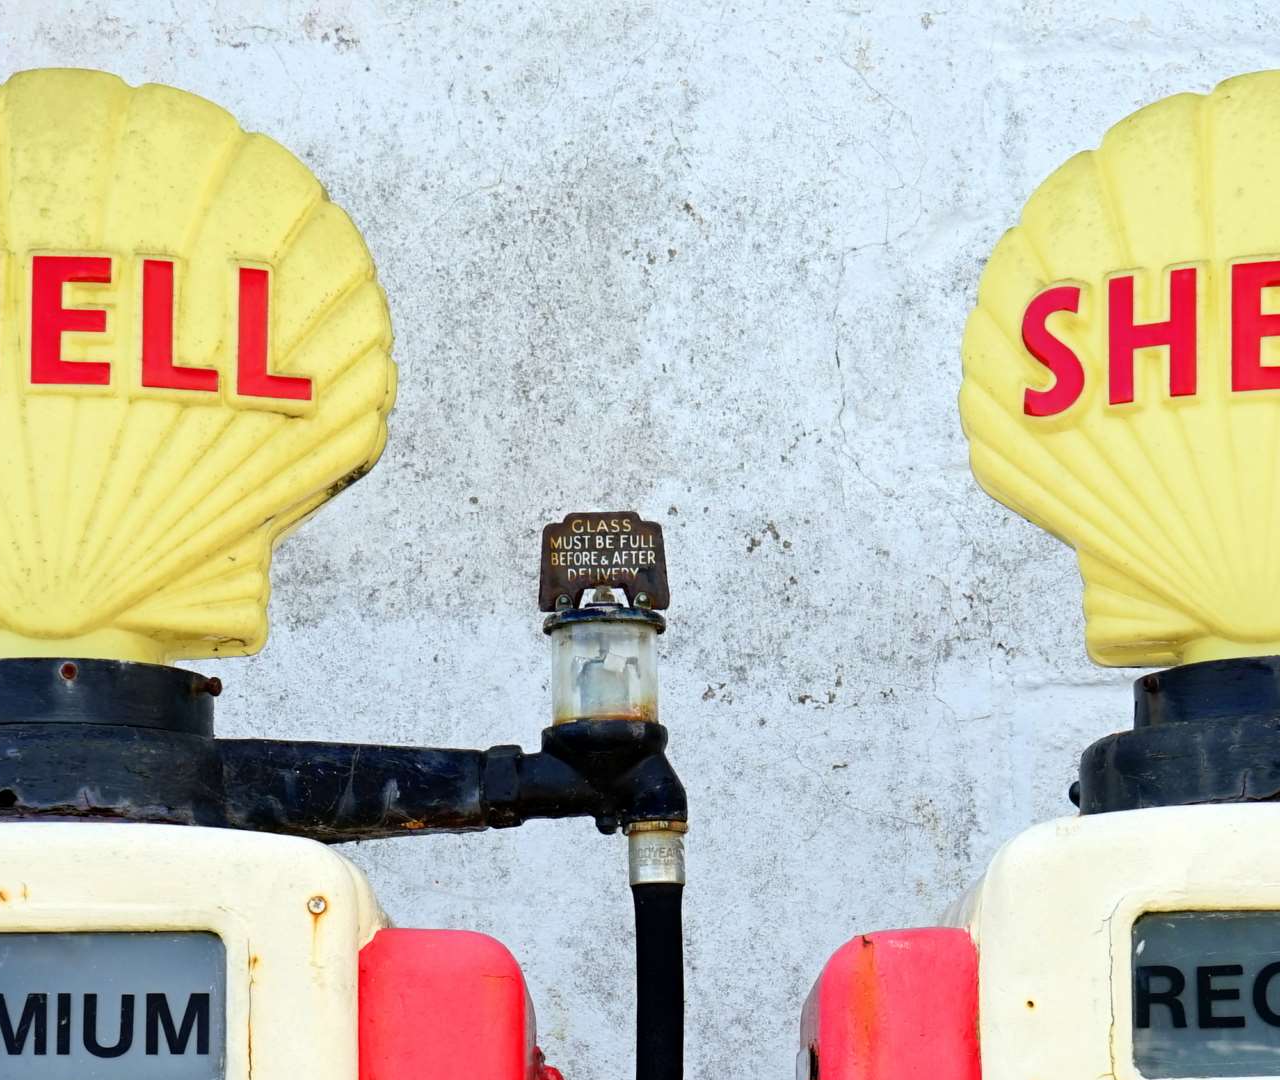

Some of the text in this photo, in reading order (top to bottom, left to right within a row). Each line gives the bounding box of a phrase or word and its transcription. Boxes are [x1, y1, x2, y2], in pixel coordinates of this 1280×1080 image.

[571, 519, 632, 533] GLASS
[550, 534, 656, 550] MUST BE FULL
[551, 550, 656, 566] BEFORE & AFTER
